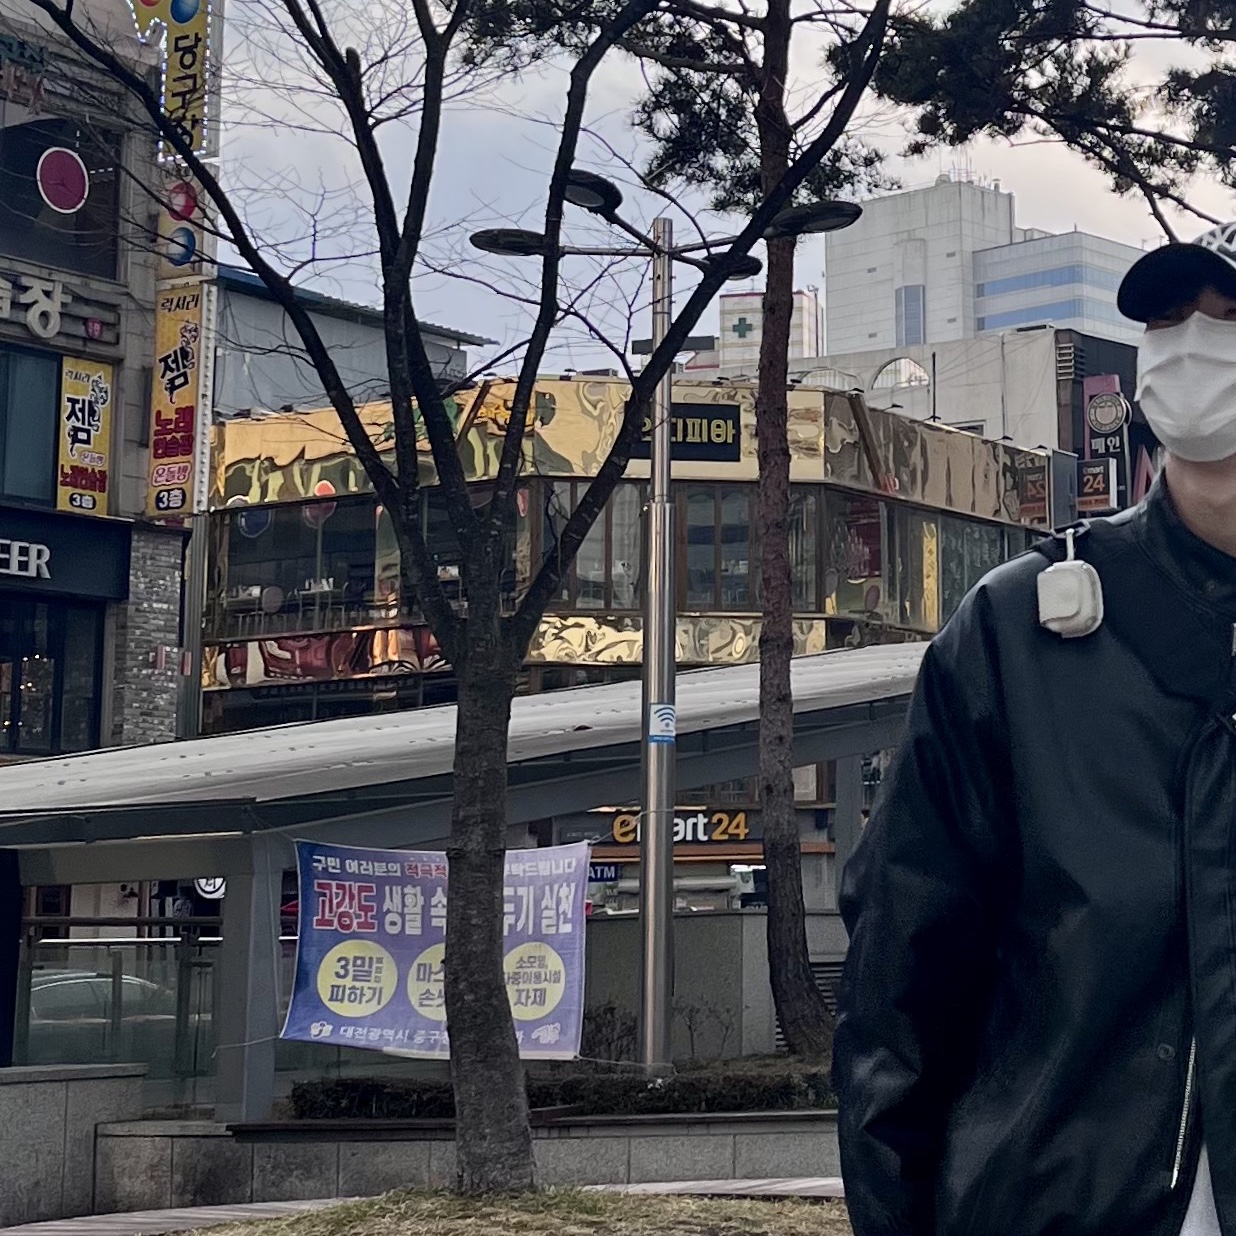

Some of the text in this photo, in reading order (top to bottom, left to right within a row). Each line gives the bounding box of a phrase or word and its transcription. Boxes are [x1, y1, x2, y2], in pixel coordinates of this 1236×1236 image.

[0, 276, 73, 338] 장
[154, 406, 195, 436] 노래
[1083, 474, 1106, 493] 24
[158, 489, 183, 509] 3층
[312, 855, 341, 874] 구민
[345, 859, 401, 877] 여러분의
[313, 880, 378, 933] 고강도
[383, 884, 425, 936] 생활
[541, 881, 576, 935] 실천
[334, 956, 373, 983] 3밀
[328, 984, 383, 1006] 피하기
[513, 987, 547, 1007] 자제
[339, 1026, 409, 1045] 대전광역시
